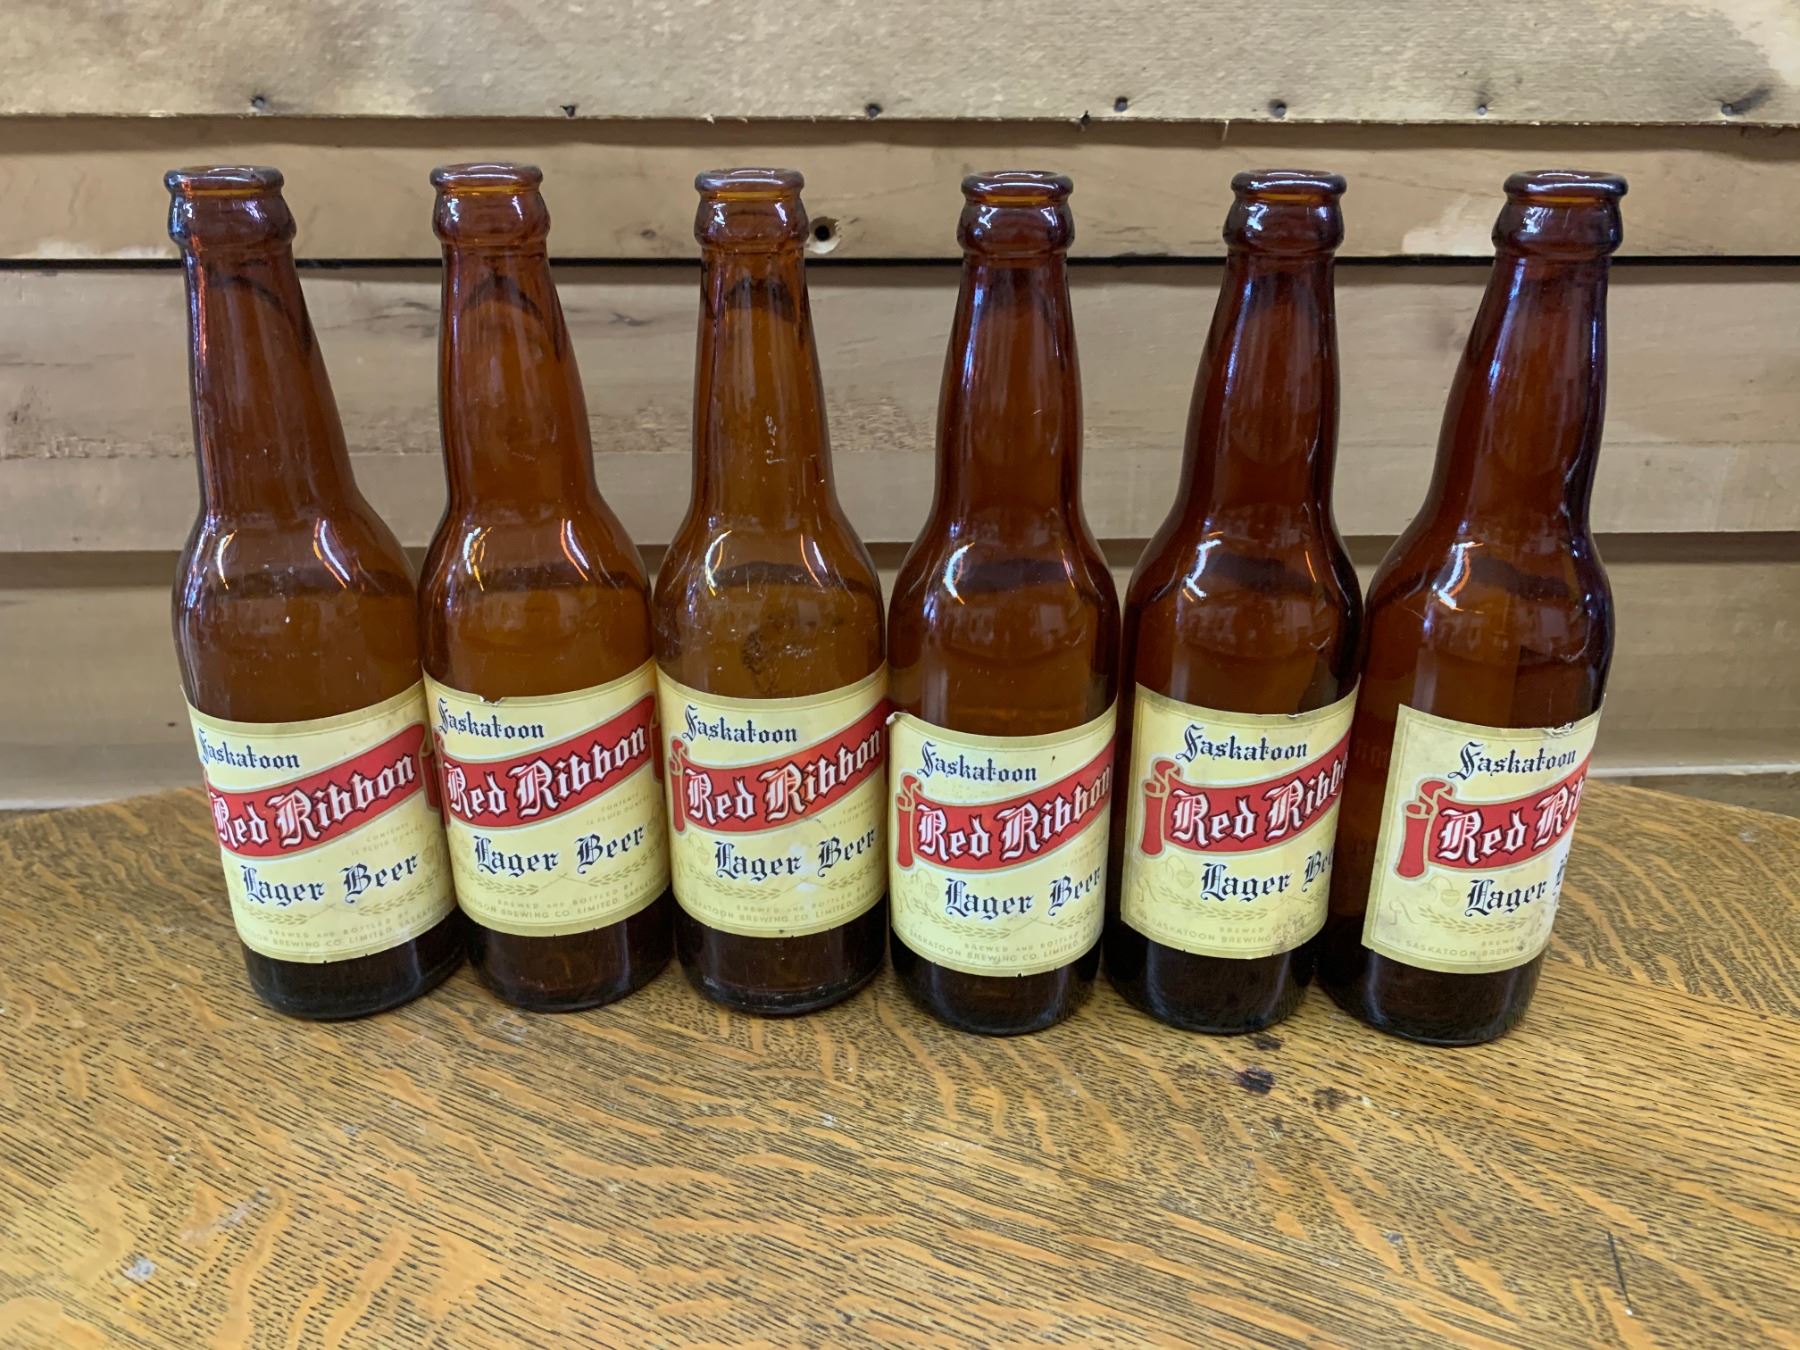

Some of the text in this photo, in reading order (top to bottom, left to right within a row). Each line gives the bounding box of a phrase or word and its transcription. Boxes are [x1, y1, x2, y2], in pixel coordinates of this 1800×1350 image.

[439, 698, 544, 740] Saskatoon
[682, 704, 798, 743] Saskatoon
[1175, 724, 1308, 763] Saskatoon
[199, 728, 300, 769] Saskatoon
[444, 725, 647, 820] Red Ribbon
[917, 741, 1037, 782] Saskatoon
[1448, 741, 1576, 781] Saskatoon
[211, 753, 416, 850] Red Ribbon
[684, 729, 880, 825] Red Ribbon
[917, 803, 992, 862] Red
[994, 764, 1111, 860] Ribbon
[1170, 787, 1257, 849] Red
[1437, 808, 1527, 865] Red
[473, 825, 645, 878] Lager Beer
[715, 826, 876, 882] Lager Beer
[241, 864, 325, 906] Lager
[340, 853, 418, 904] Beer
[945, 867, 1101, 920] Lager Beer
[1201, 862, 1292, 902] Lager
[1465, 879, 1547, 918] Lager
